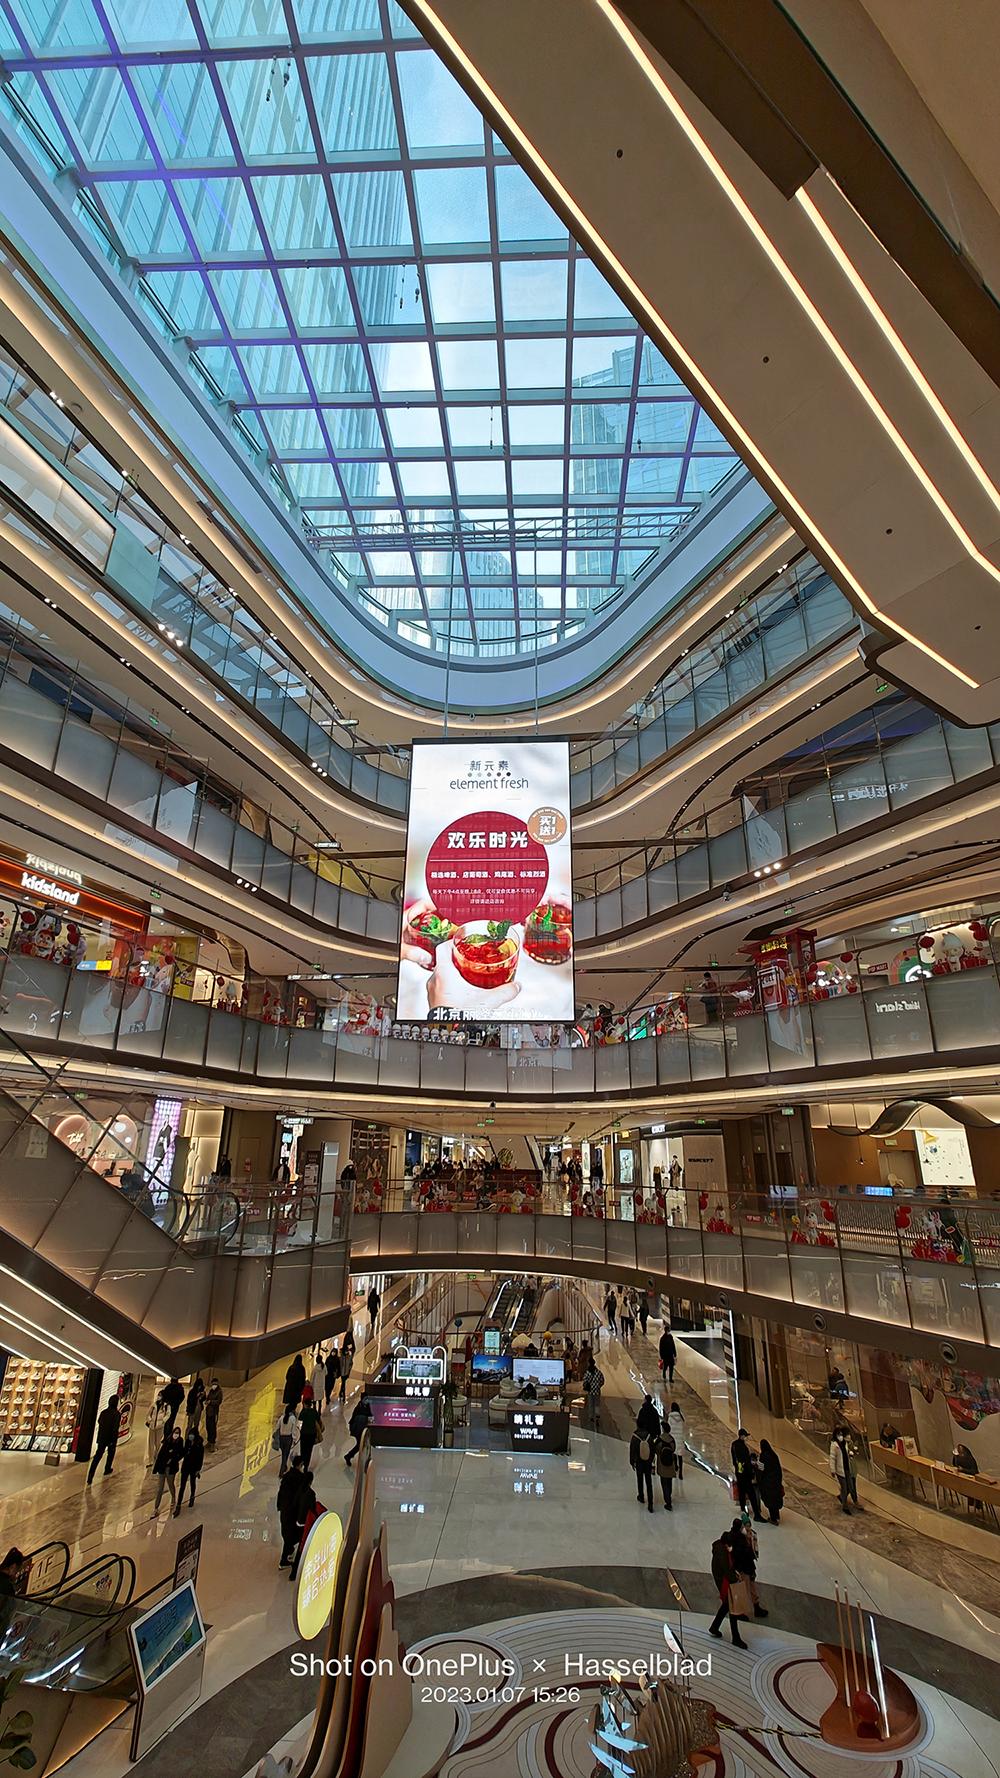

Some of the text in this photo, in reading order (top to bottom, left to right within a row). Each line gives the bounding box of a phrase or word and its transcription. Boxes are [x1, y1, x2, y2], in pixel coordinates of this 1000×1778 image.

[469, 760, 509, 771] 新元素
[449, 776, 529, 790] element fresh
[539, 815, 556, 826] 买1
[539, 825, 556, 836] 送1
[447, 831, 528, 849] 欢乐时光
[20, 872, 80, 906] kidsland
[37, 1554, 54, 1578] 1F
